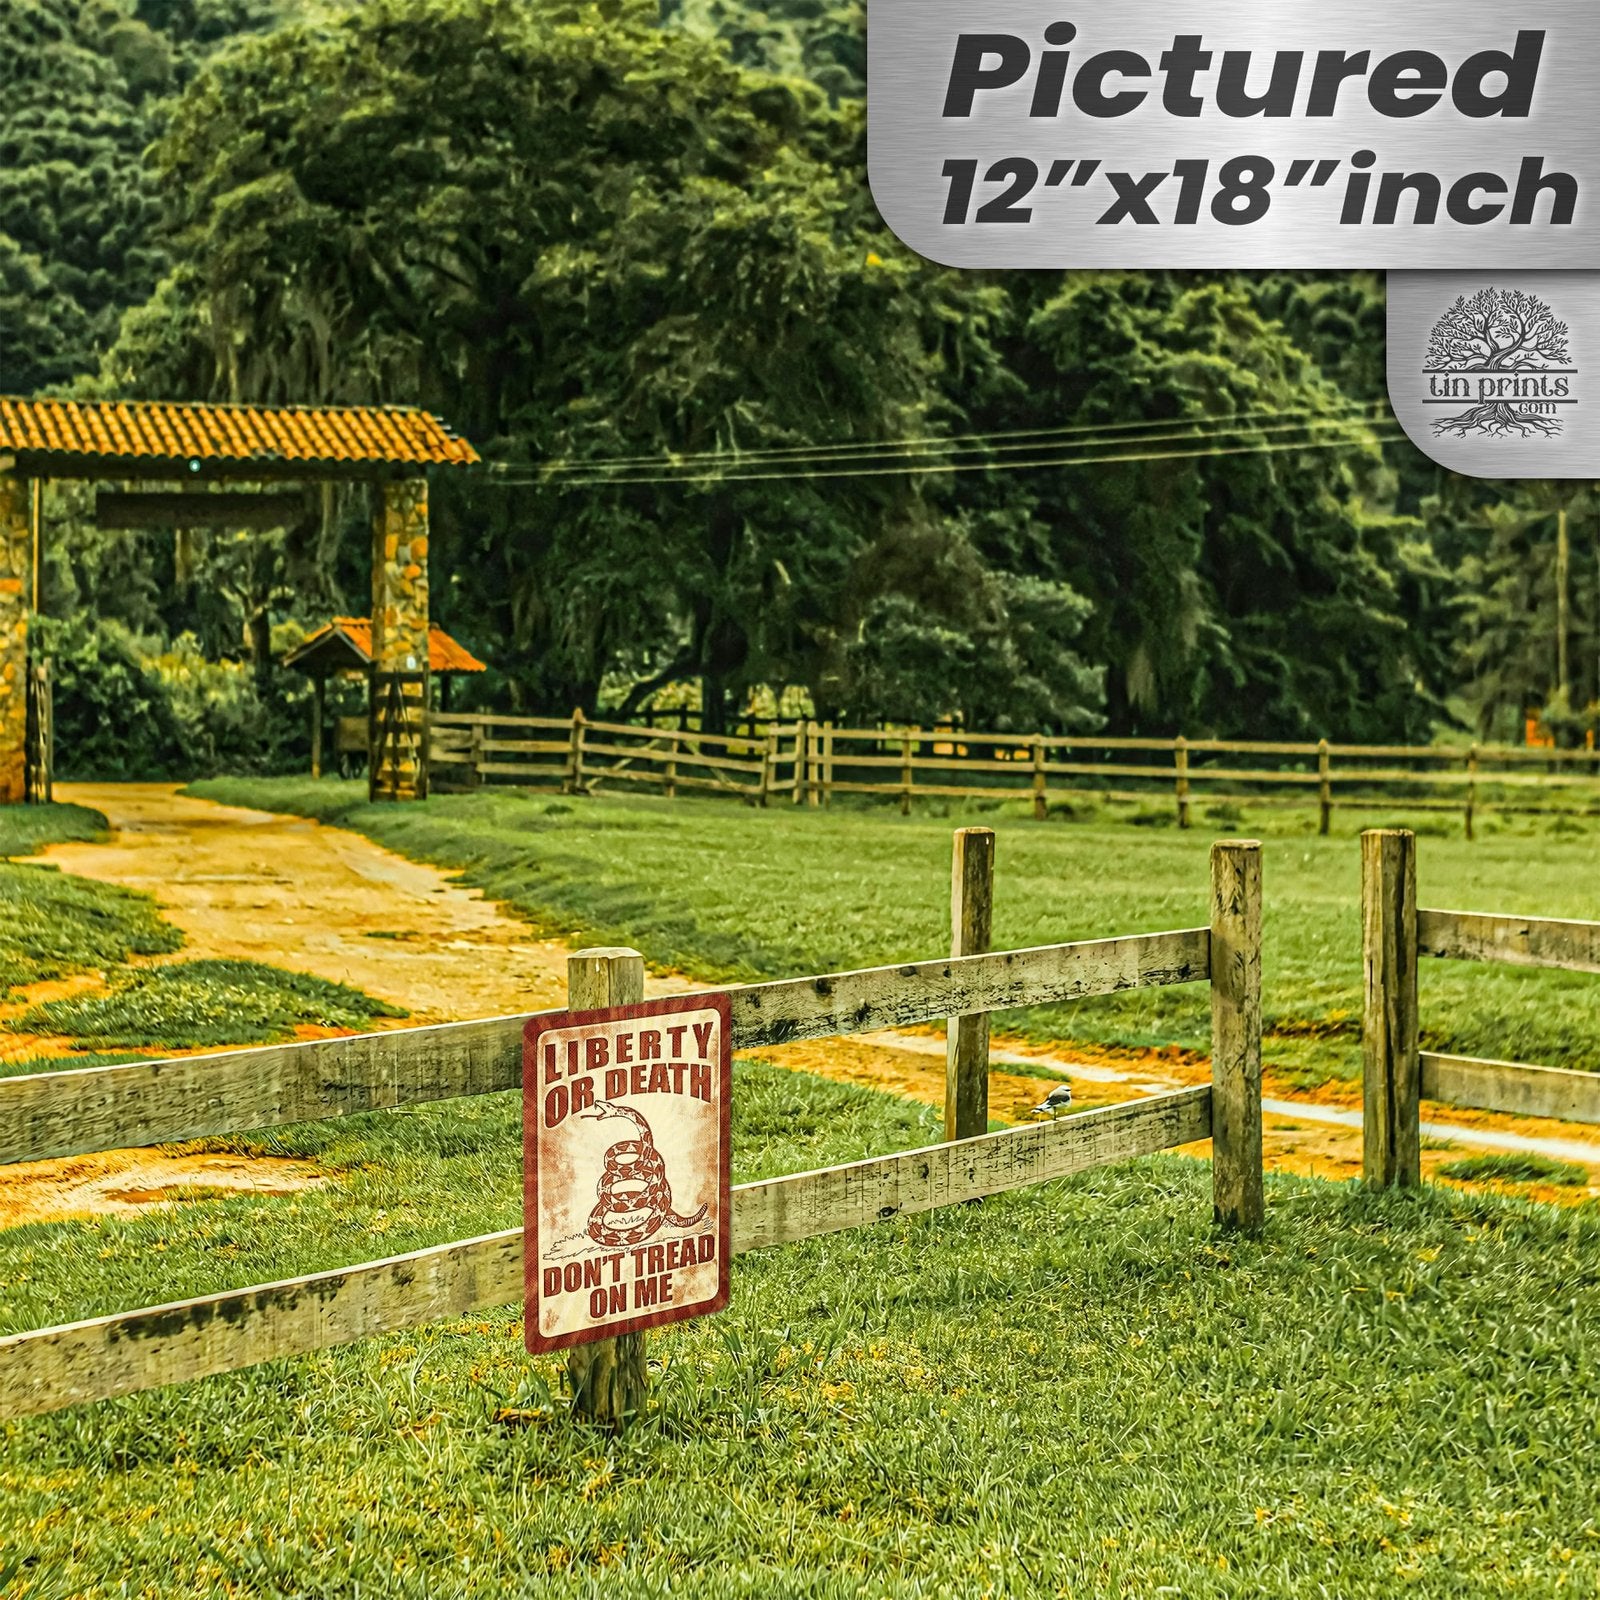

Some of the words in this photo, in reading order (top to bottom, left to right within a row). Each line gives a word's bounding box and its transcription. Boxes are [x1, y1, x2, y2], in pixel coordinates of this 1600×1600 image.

[545, 1021, 714, 1085] LIBERTY
[545, 1076, 594, 1128] OR
[605, 1063, 712, 1103] DEATH
[543, 1253, 625, 1298] DON'T
[630, 1234, 715, 1278] TREAD
[589, 1283, 627, 1318] ON
[634, 1273, 673, 1308] ME
